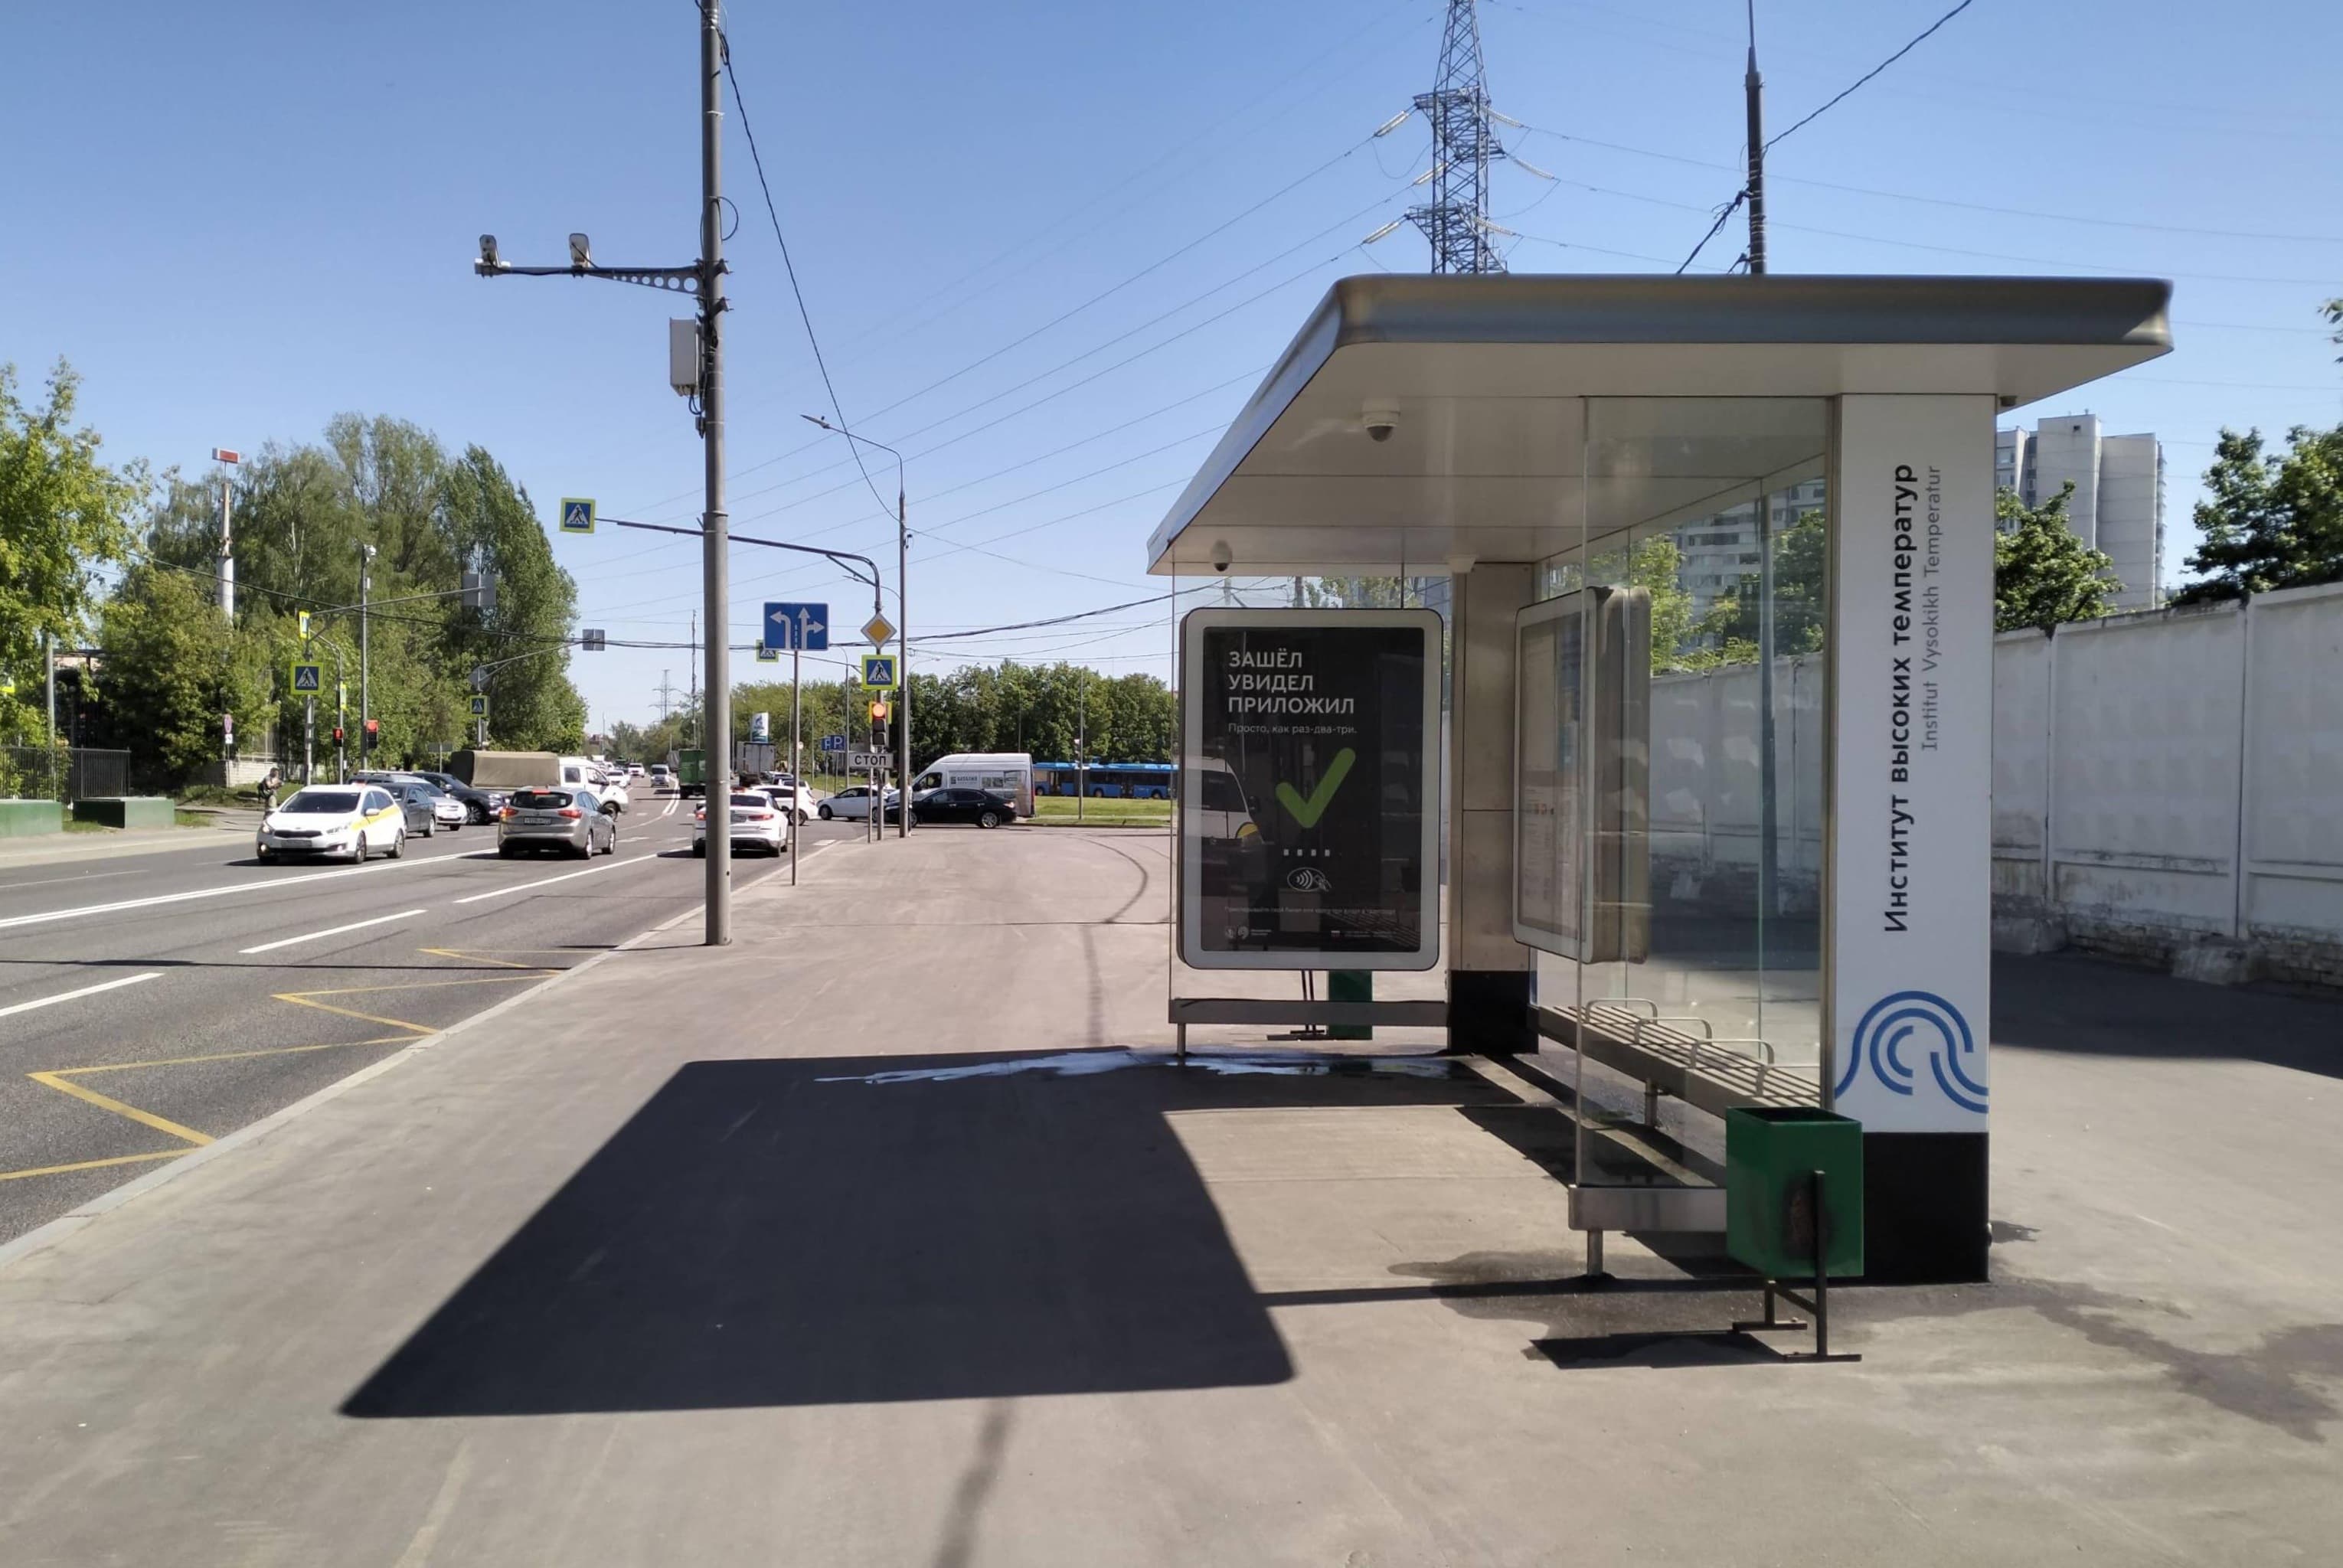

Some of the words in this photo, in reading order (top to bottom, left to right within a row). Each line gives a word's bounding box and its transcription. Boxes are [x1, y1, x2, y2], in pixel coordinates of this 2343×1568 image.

[1894, 465, 1918, 646] температур
[1923, 466, 1943, 577] Temperatur
[1229, 648, 1302, 668] ЗАШЁЛ
[1922, 586, 1942, 671] Vysokikh
[1228, 674, 1313, 693] УВИДЕЛ
[1228, 697, 1354, 714] ПРИЛОЖИЛ
[1921, 681, 1939, 751] Institut
[1228, 723, 1270, 733] Просто,
[1292, 726, 1358, 735] раз-два-три.
[1891, 657, 1911, 782] высоких
[855, 755, 887, 766] СТОП
[1884, 794, 1914, 932] Институт
